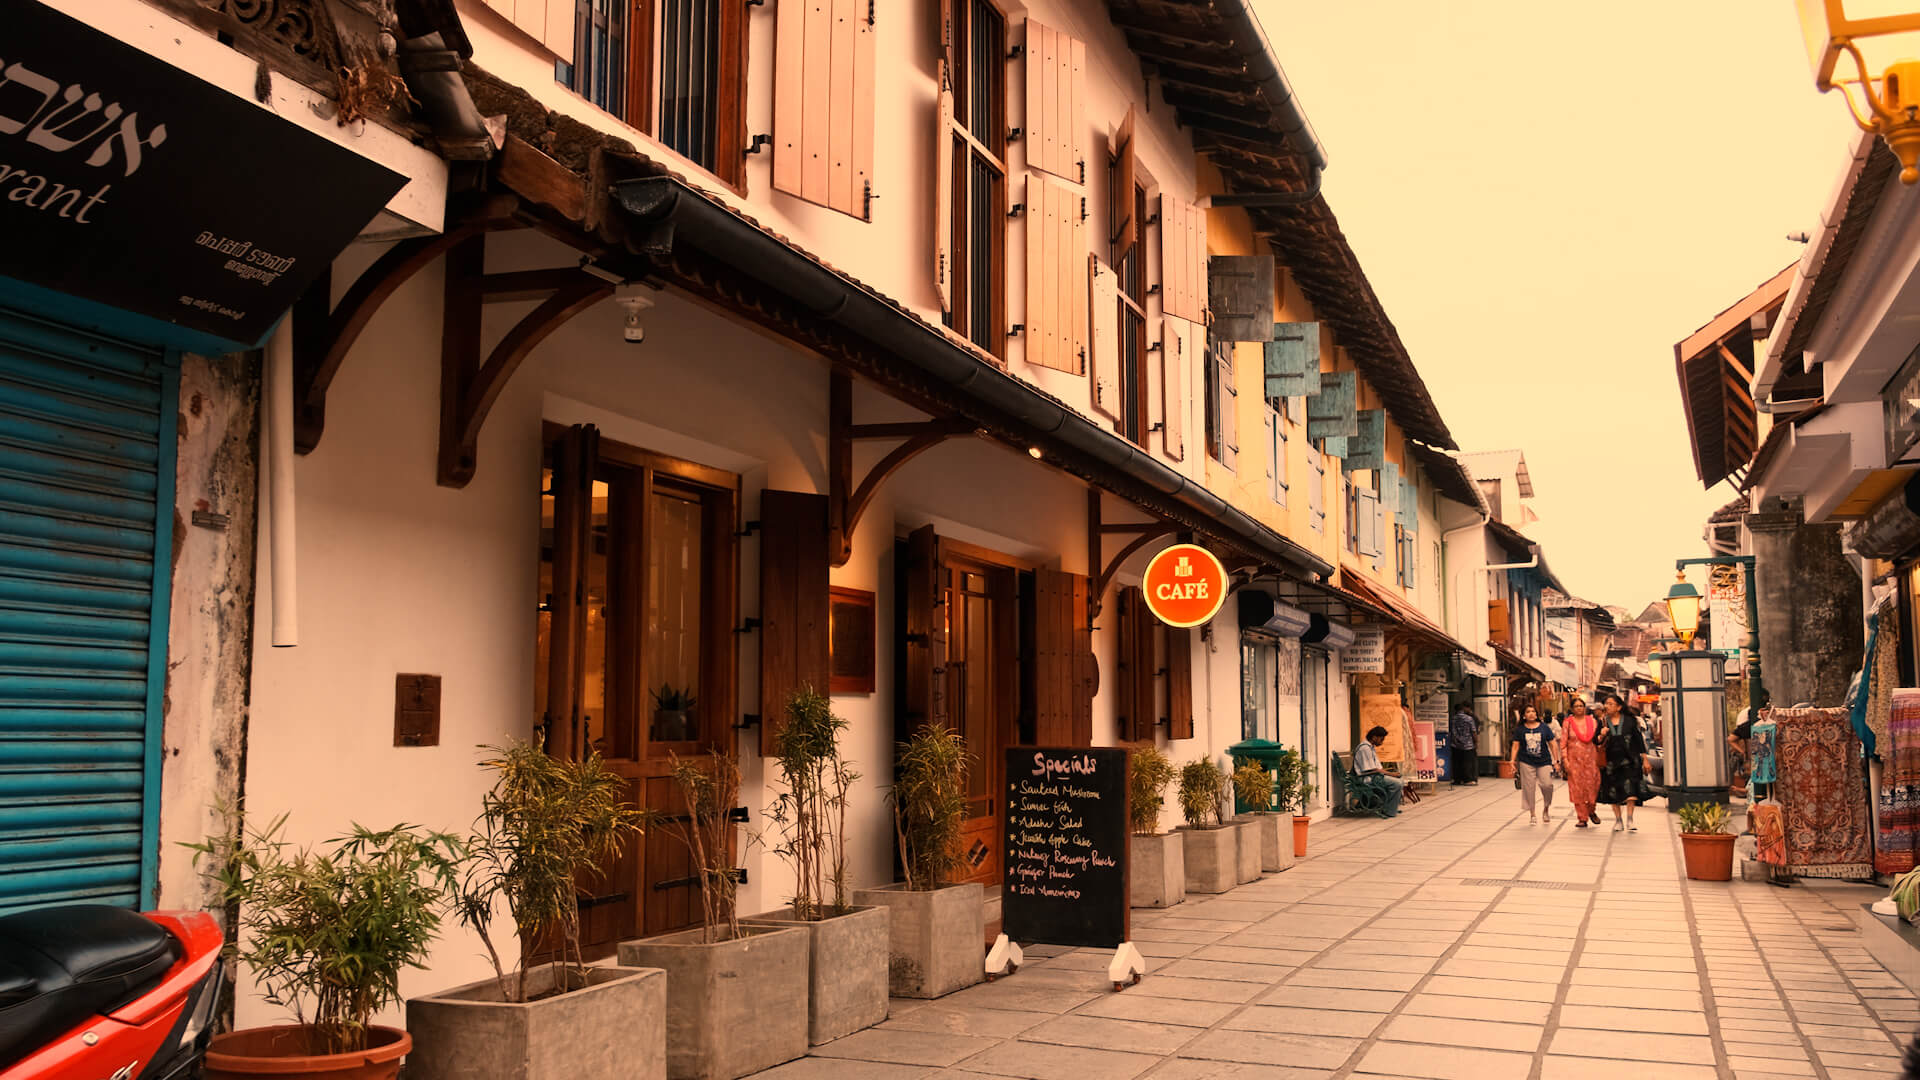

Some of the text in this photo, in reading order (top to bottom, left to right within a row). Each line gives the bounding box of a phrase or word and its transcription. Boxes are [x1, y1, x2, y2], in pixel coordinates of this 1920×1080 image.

[1156, 578, 1209, 601] CAFÉ
[1032, 752, 1097, 782] Specials
[1059, 815, 1083, 830] Salad
